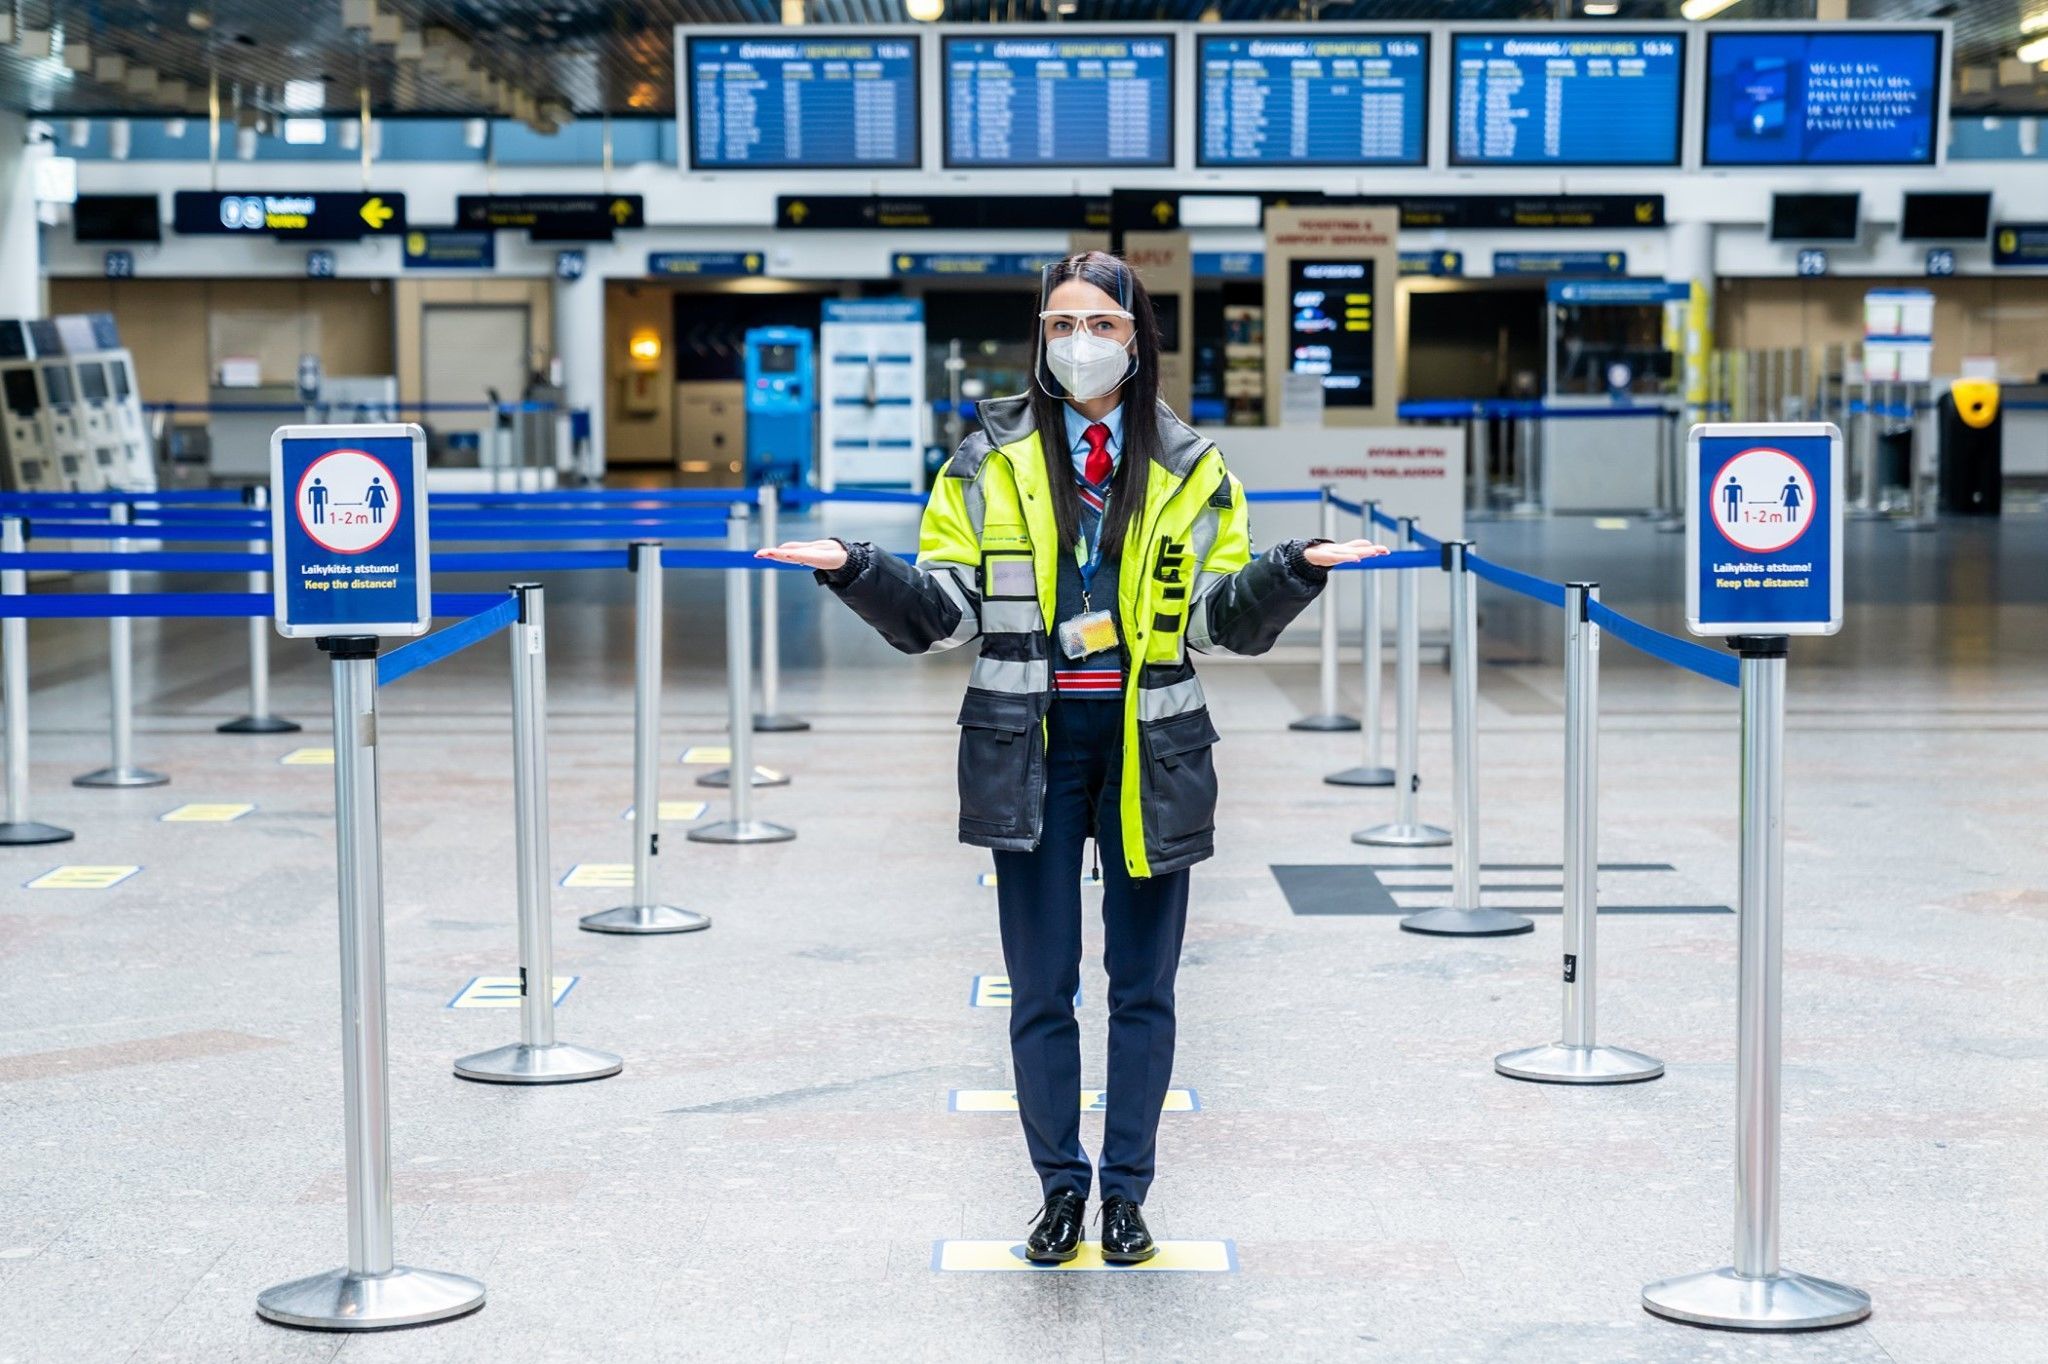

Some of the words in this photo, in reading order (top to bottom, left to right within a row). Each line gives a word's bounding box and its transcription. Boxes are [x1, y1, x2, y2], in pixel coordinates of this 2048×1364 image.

[355, 513, 369, 525] m
[1769, 513, 1783, 523] m
[354, 563, 400, 574] atstumo!
[1766, 562, 1812, 573] atstumo!
[304, 580, 330, 591] Keep
[332, 580, 349, 589] the
[351, 579, 397, 589] distance!
[1716, 579, 1742, 590] Keep
[1744, 579, 1761, 588] the
[1762, 578, 1809, 588] distance!
